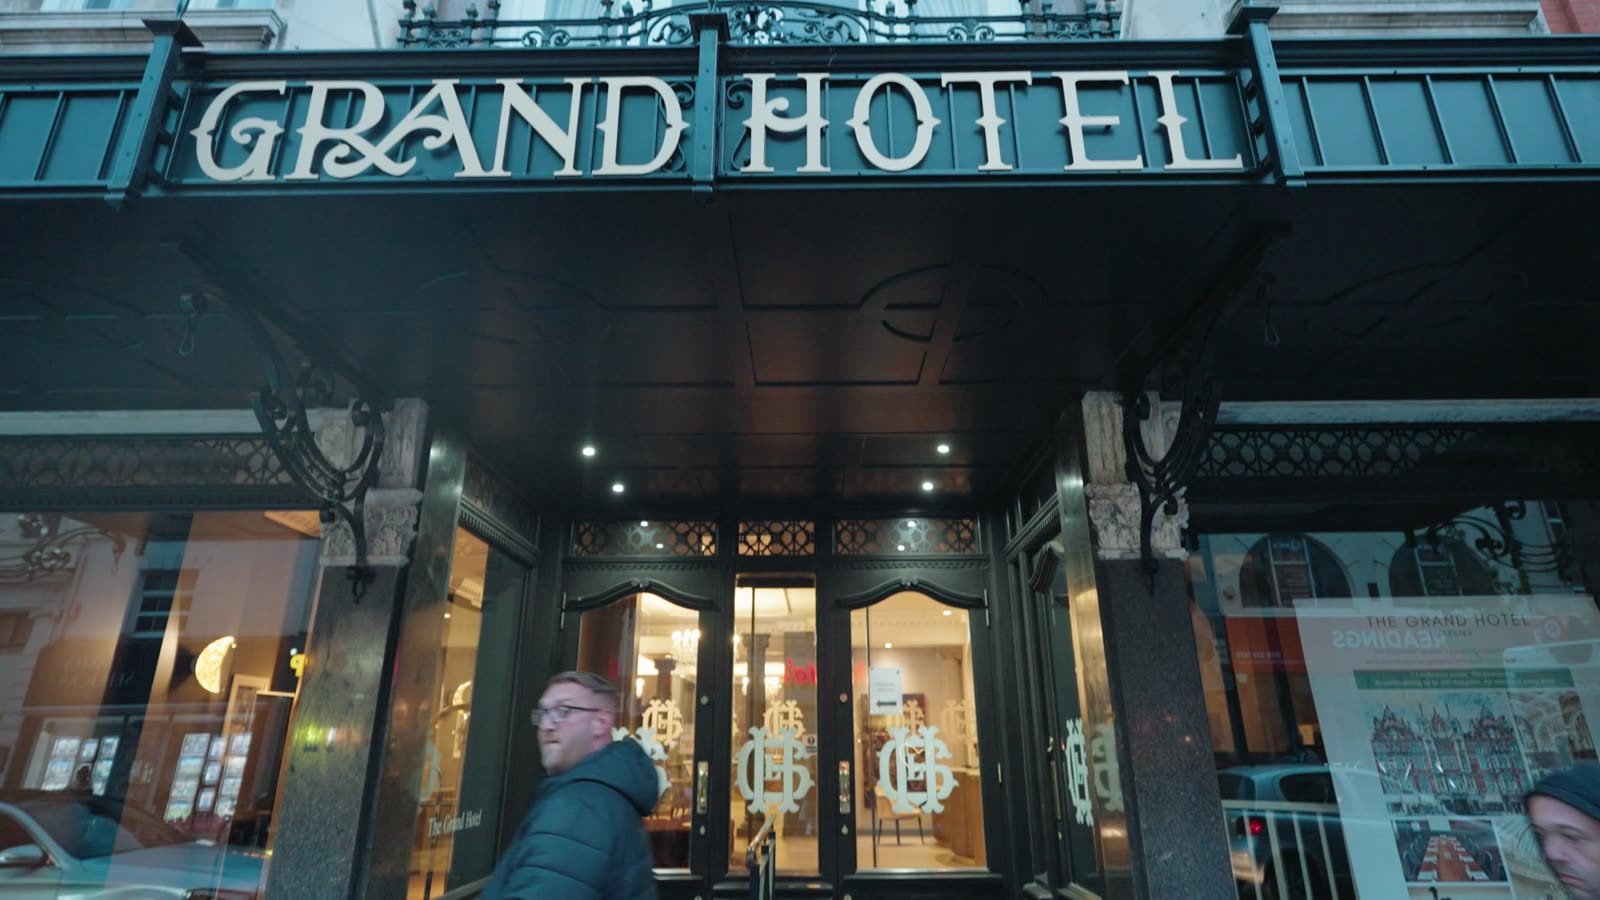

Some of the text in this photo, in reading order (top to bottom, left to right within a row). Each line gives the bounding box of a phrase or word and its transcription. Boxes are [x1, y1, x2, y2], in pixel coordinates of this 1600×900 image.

[190, 70, 1243, 181] GRAND HOTEL
[1367, 613, 1530, 628] THE GRAND HOTEL
[428, 808, 483, 837] The Grand Hotel
